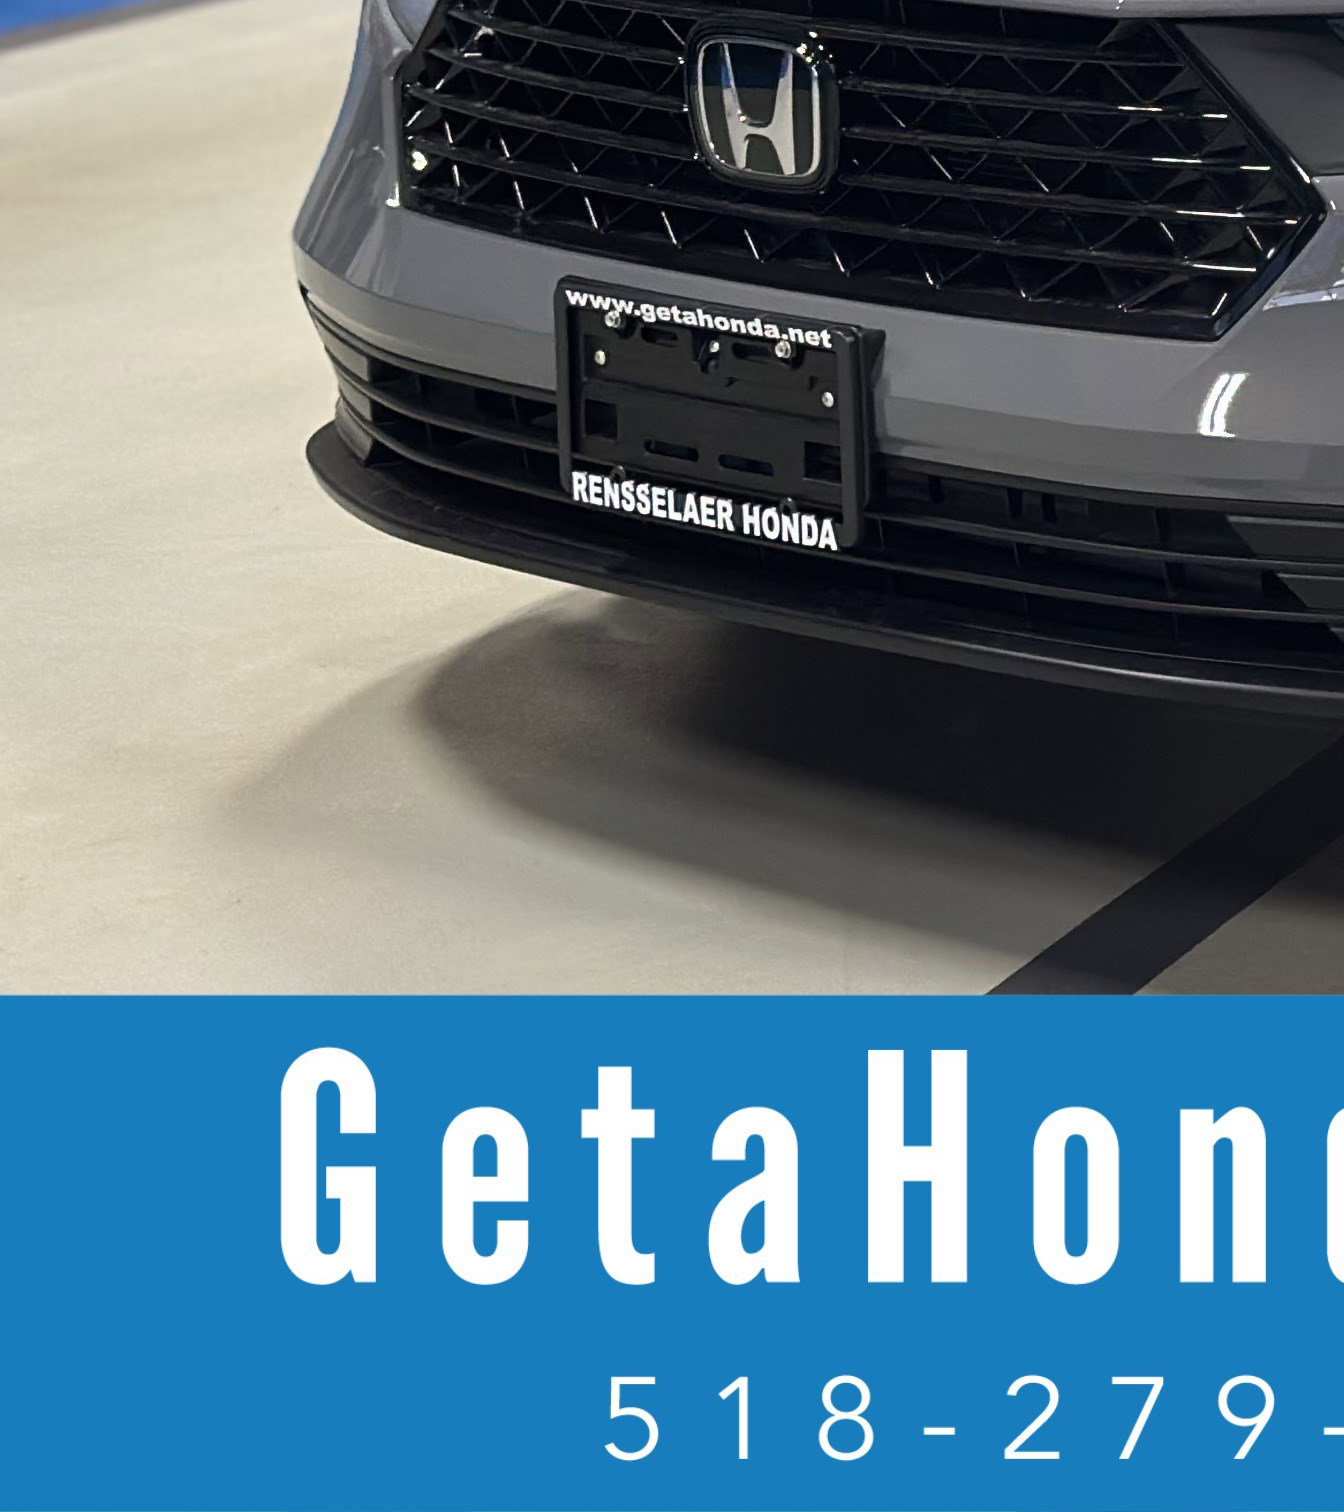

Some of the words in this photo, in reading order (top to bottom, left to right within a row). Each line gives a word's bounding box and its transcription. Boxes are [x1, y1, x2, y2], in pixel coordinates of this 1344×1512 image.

[565, 288, 833, 350] www.getahonda.net
[571, 470, 736, 532] RENSSELAER
[742, 502, 839, 551] HONDA
